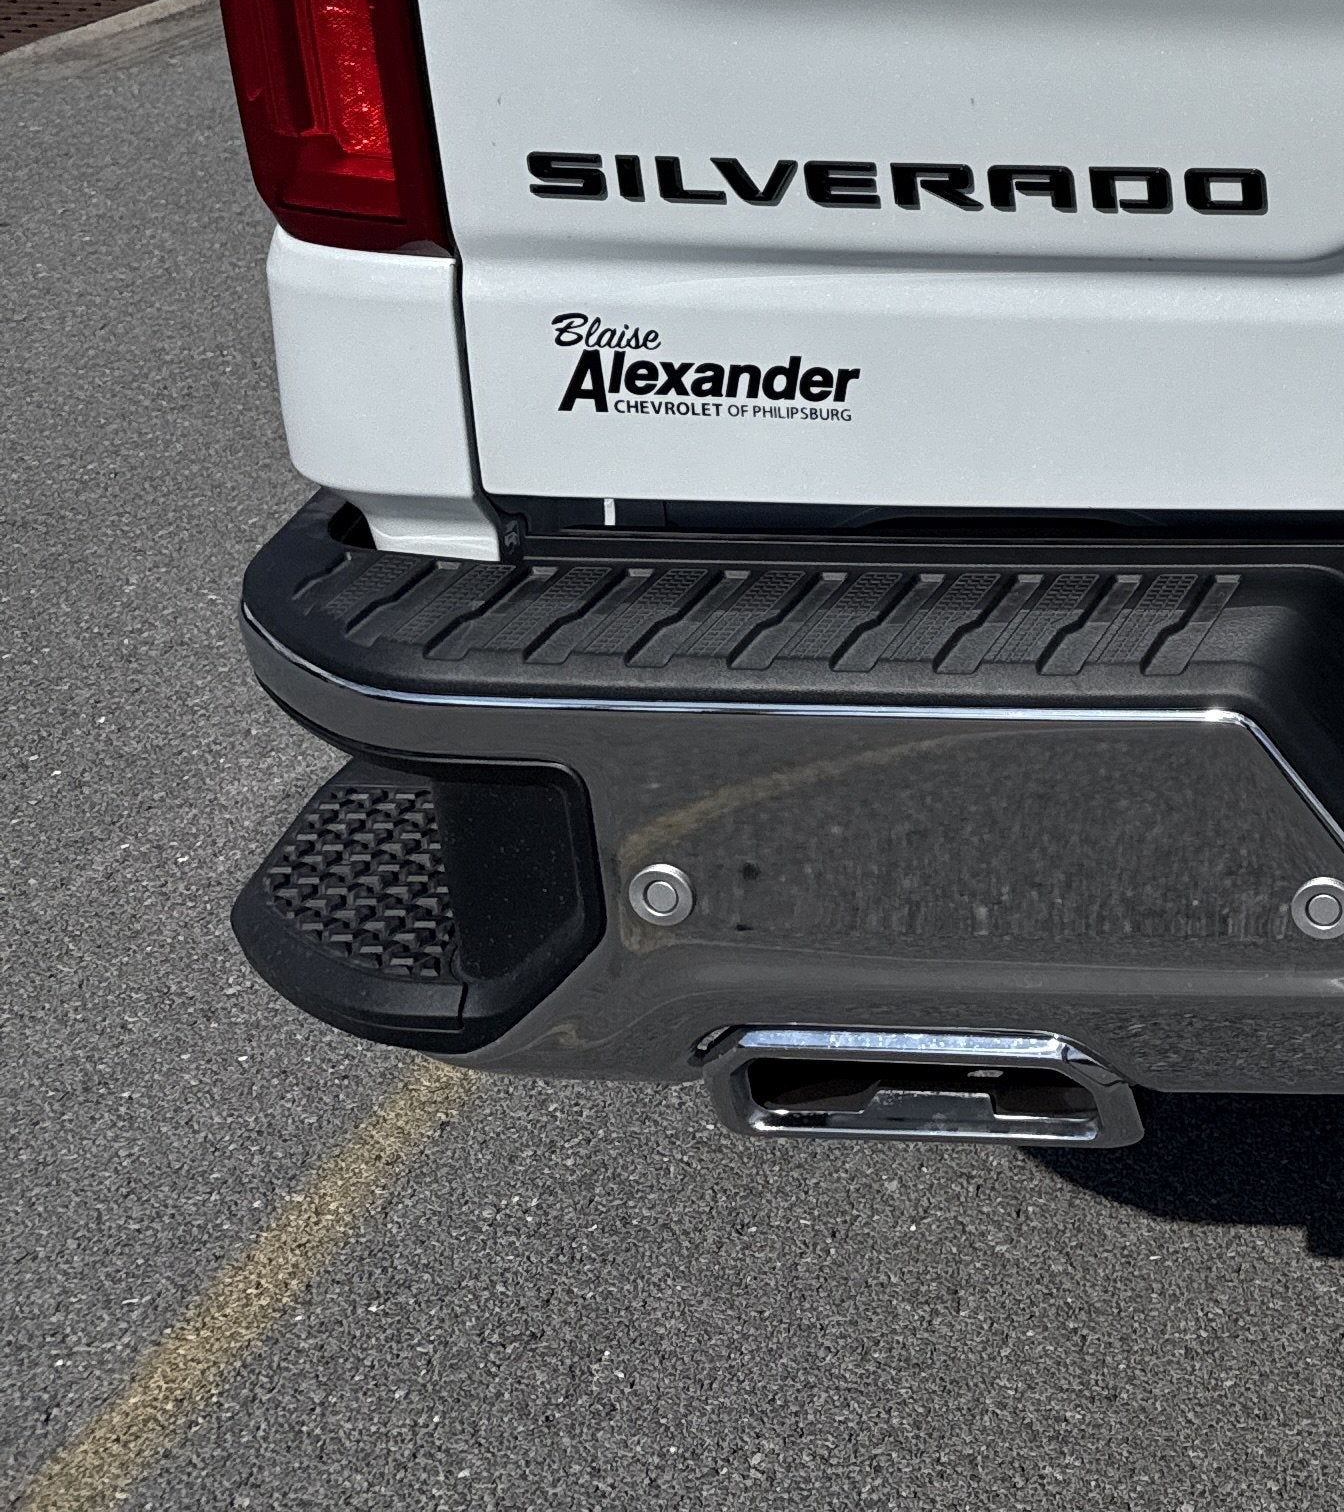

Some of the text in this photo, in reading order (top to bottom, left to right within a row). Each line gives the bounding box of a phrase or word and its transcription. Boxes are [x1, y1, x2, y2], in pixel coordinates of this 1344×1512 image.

[526, 151, 1269, 216] SILVERADO
[551, 312, 662, 351] Blaise
[557, 348, 861, 413] Alexander
[613, 399, 852, 422] CHEVROLET OF PHILIPSBURG
